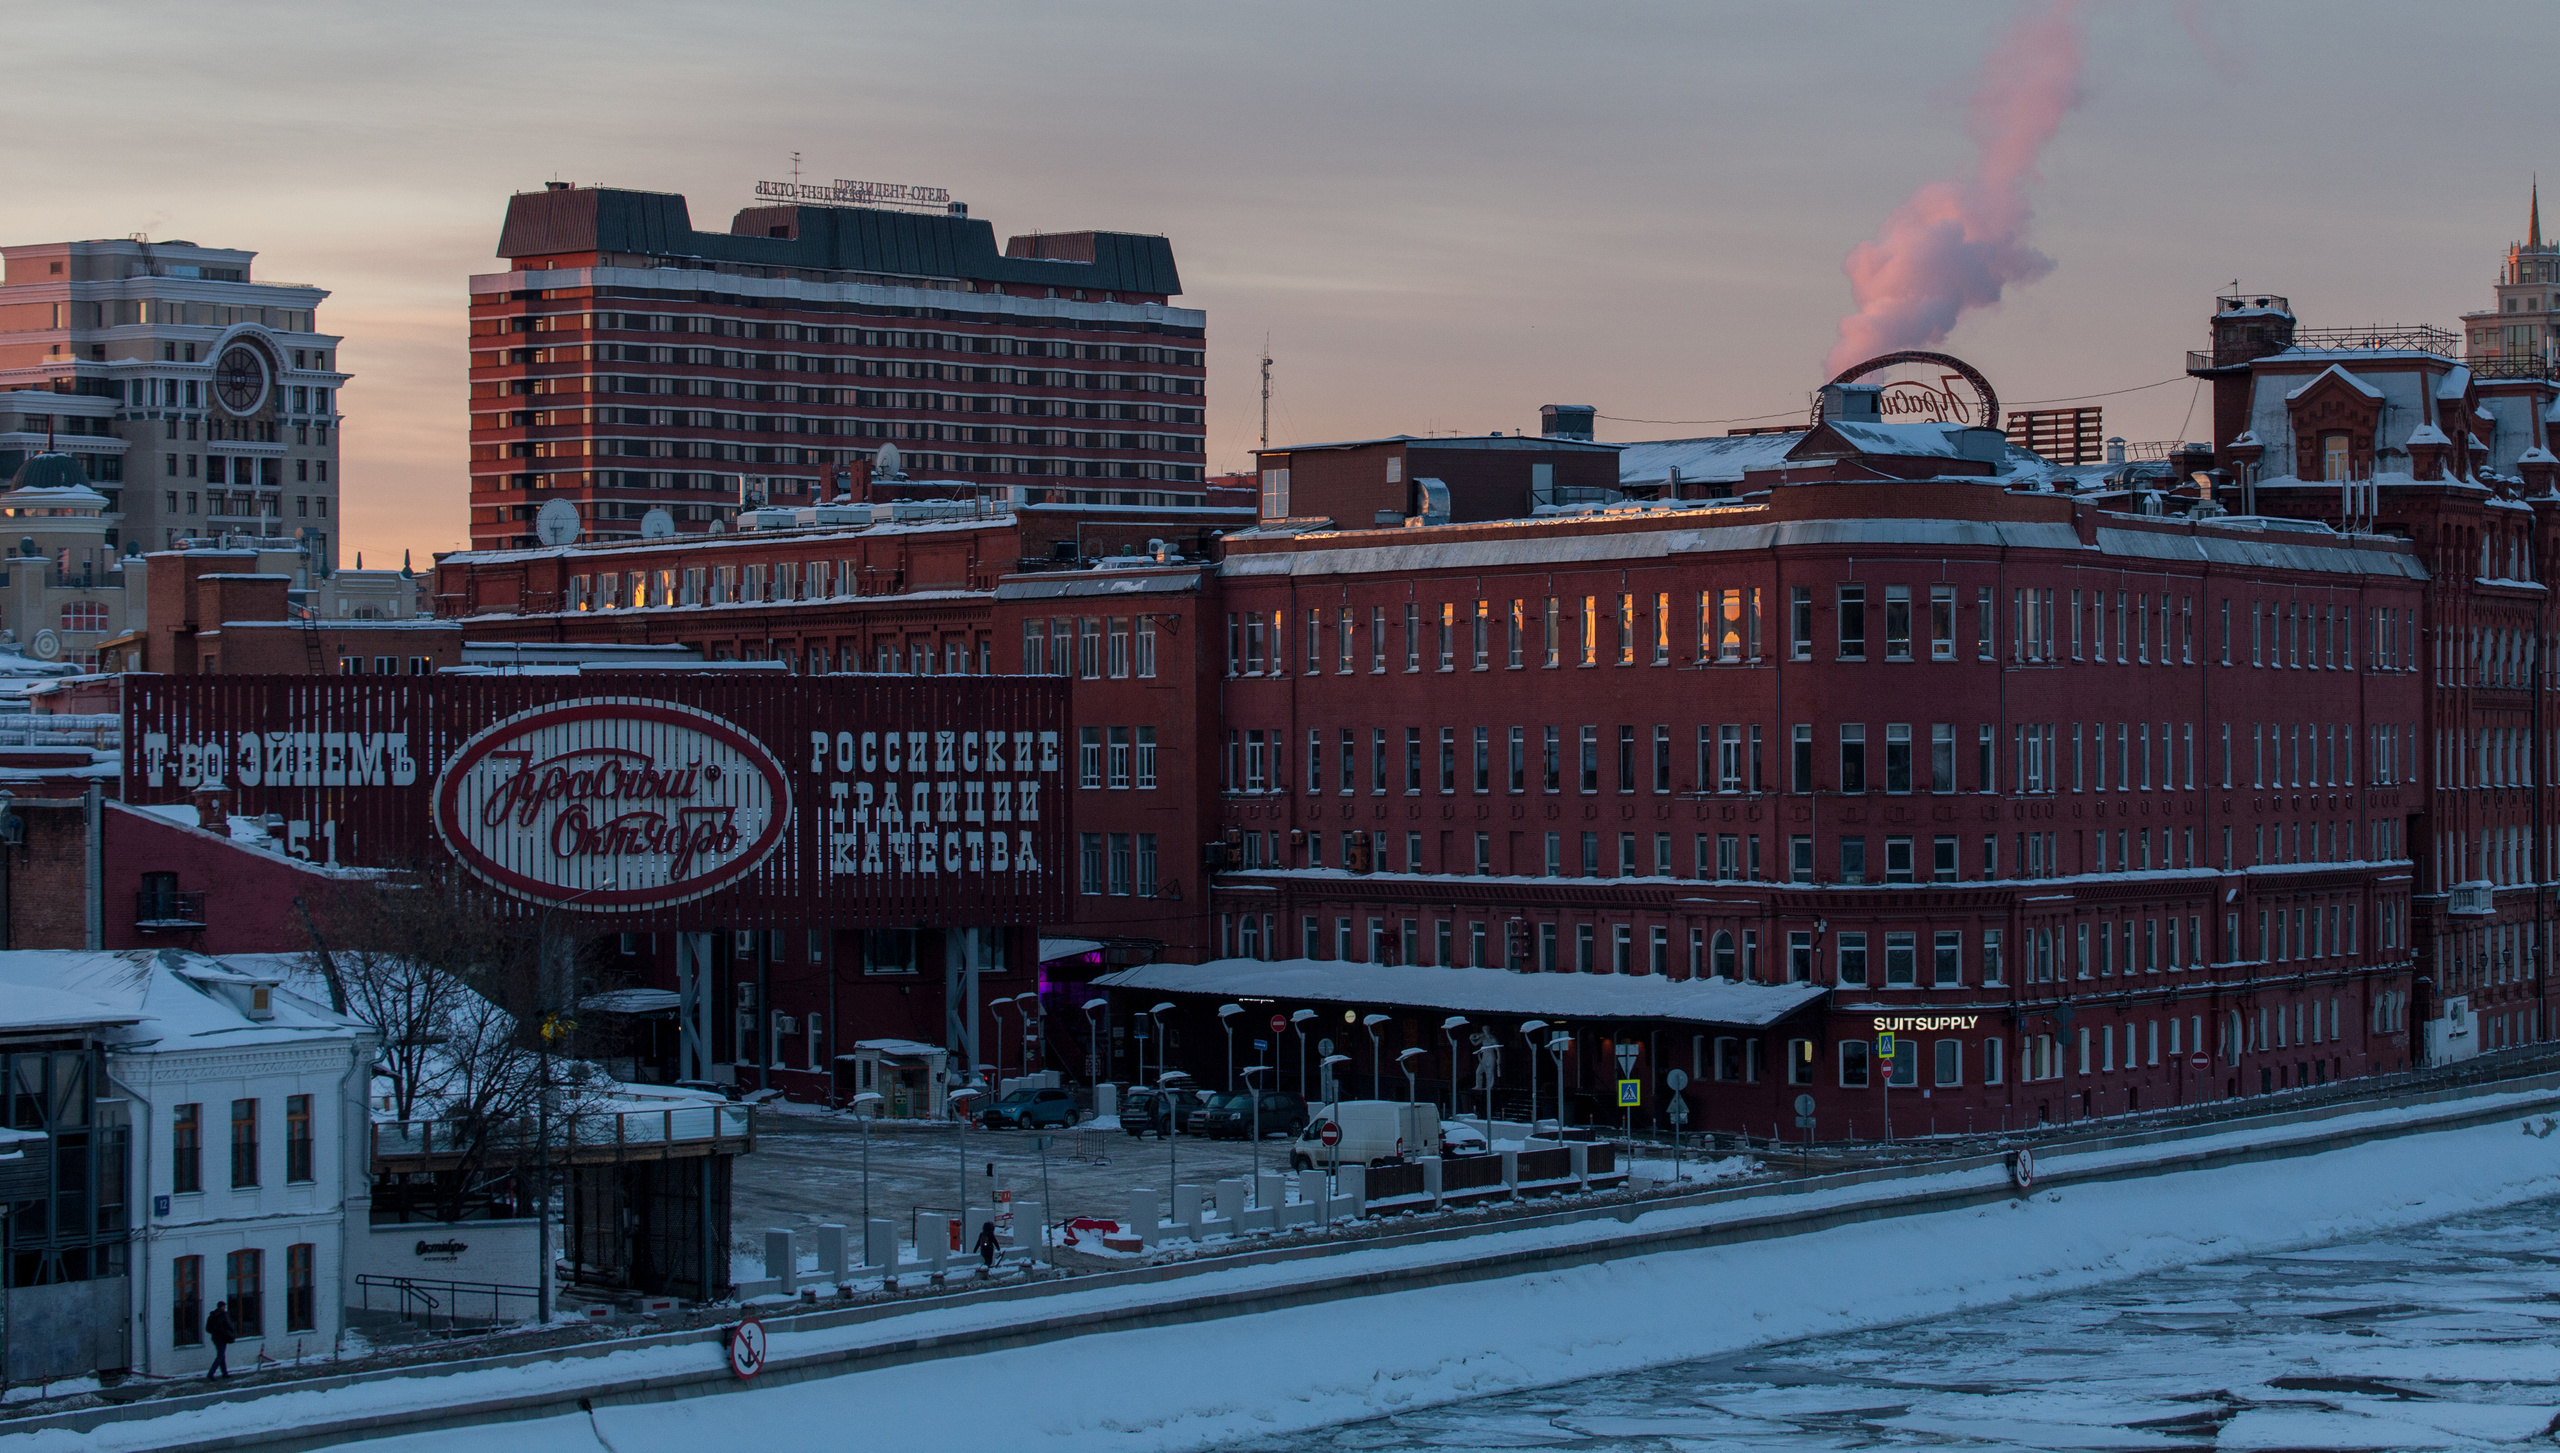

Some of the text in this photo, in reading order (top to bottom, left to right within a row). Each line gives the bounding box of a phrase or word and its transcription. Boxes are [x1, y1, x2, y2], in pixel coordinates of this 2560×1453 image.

[239, 732, 416, 787] ЭЙНЕМЪ
[811, 731, 1058, 773] РОССИЙСКИЕ
[484, 747, 701, 827] Красный
[831, 781, 1038, 827] ТРАДИЦИИ
[551, 803, 743, 880] Октябрь
[832, 830, 1037, 874] КАЧЕСТВА
[1873, 1016, 1978, 1031] SUITSUPPLY
